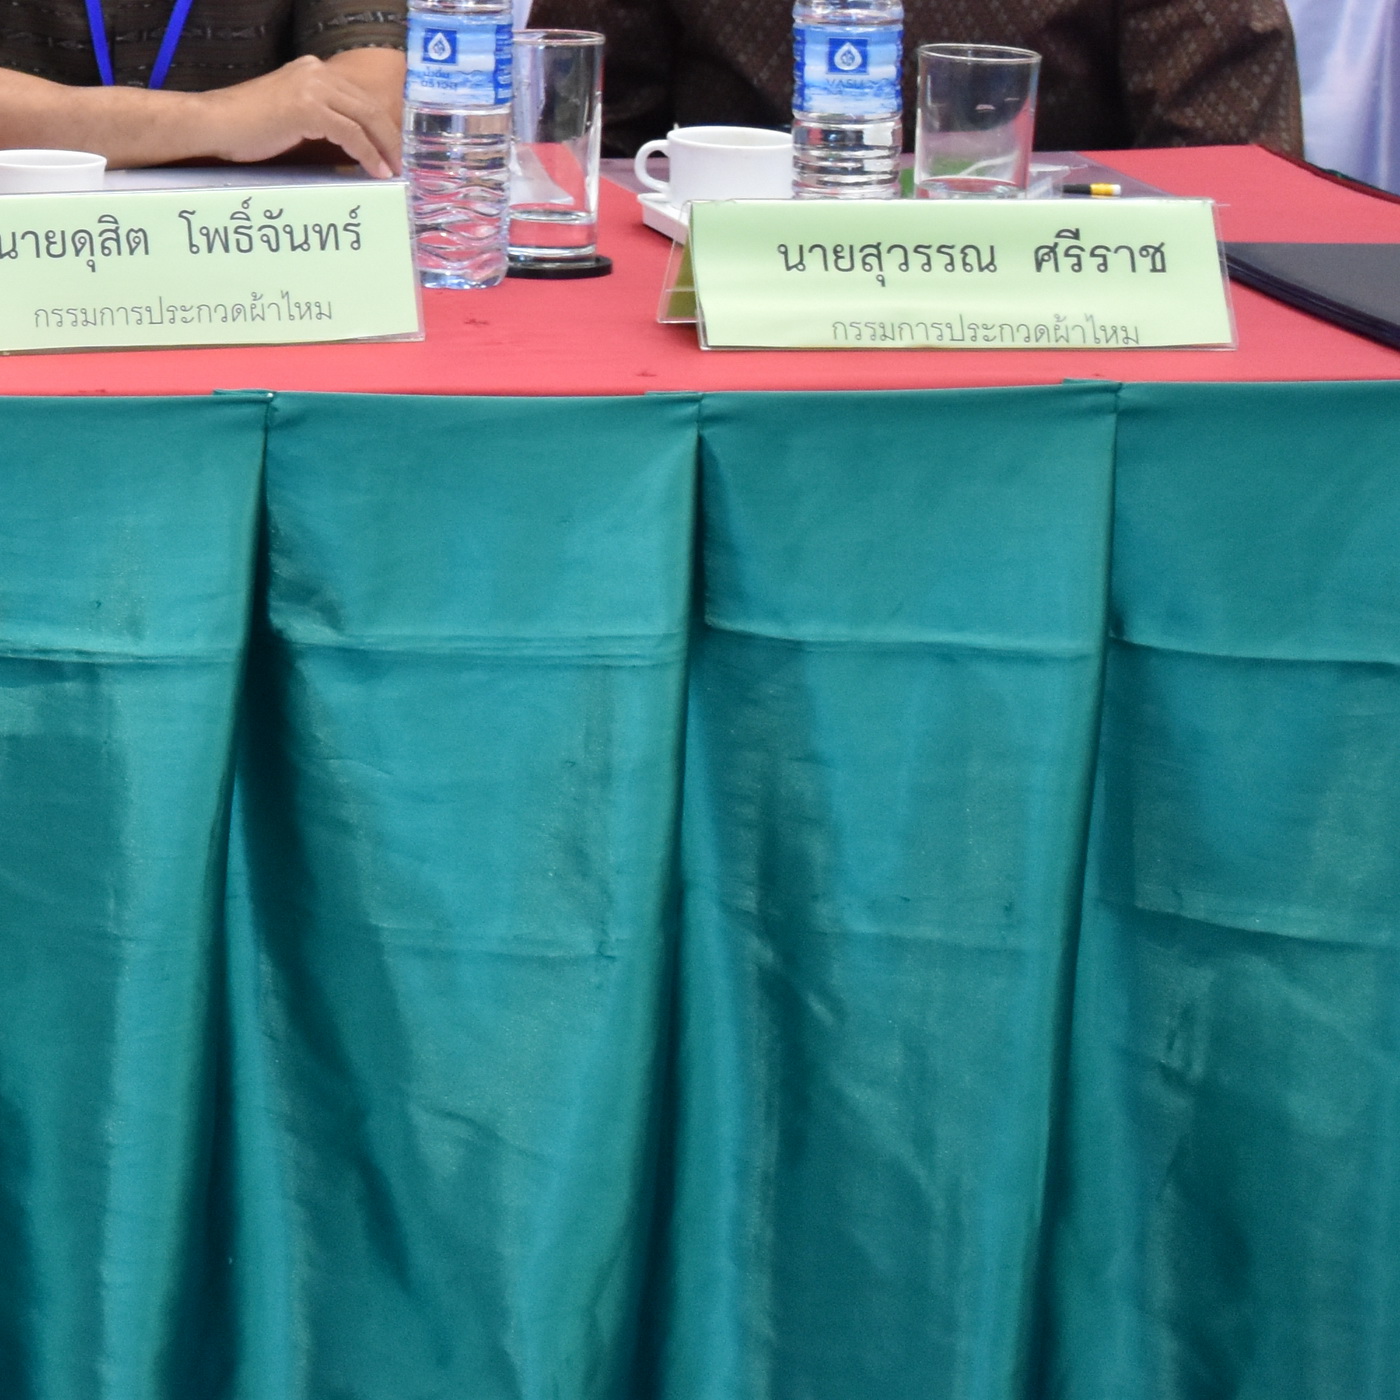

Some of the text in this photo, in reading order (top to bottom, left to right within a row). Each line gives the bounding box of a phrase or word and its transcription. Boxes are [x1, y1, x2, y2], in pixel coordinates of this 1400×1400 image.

[177, 195, 363, 256] โพธิ์จันทร์
[776, 227, 1168, 288] นายสุวรรณ ศรีราช
[33, 289, 333, 328] กรรมการประกวดผ้าไหม
[831, 313, 1141, 346] กรรมการประกวดผ้าไหม
